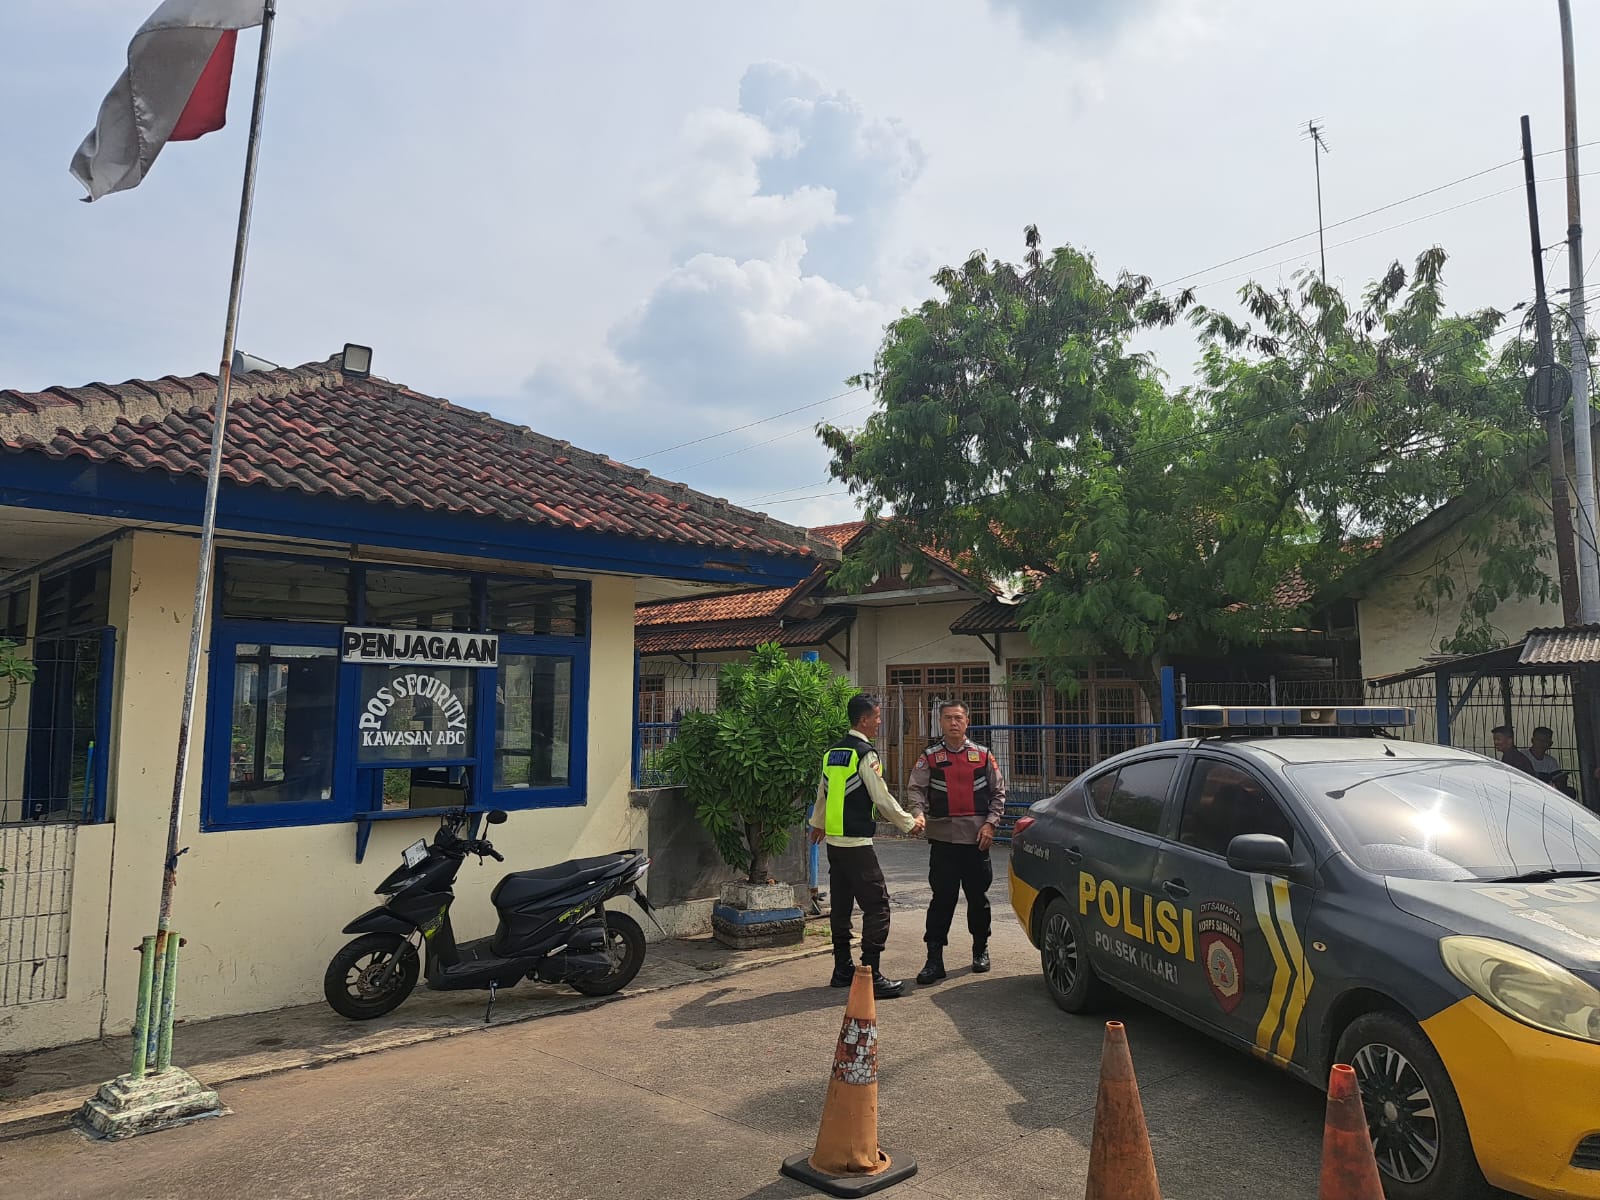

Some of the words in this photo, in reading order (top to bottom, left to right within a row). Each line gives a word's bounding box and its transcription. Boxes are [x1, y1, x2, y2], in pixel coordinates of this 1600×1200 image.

[343, 632, 497, 663] PENJAGAAN
[358, 686, 395, 730] POS
[392, 673, 467, 729] SECURITY
[362, 731, 432, 746] KAWASAN
[436, 730, 465, 745] ABC
[1079, 871, 1195, 962] POLISI
[1095, 931, 1138, 966] POLSEK
[1141, 951, 1178, 985] KLARI
